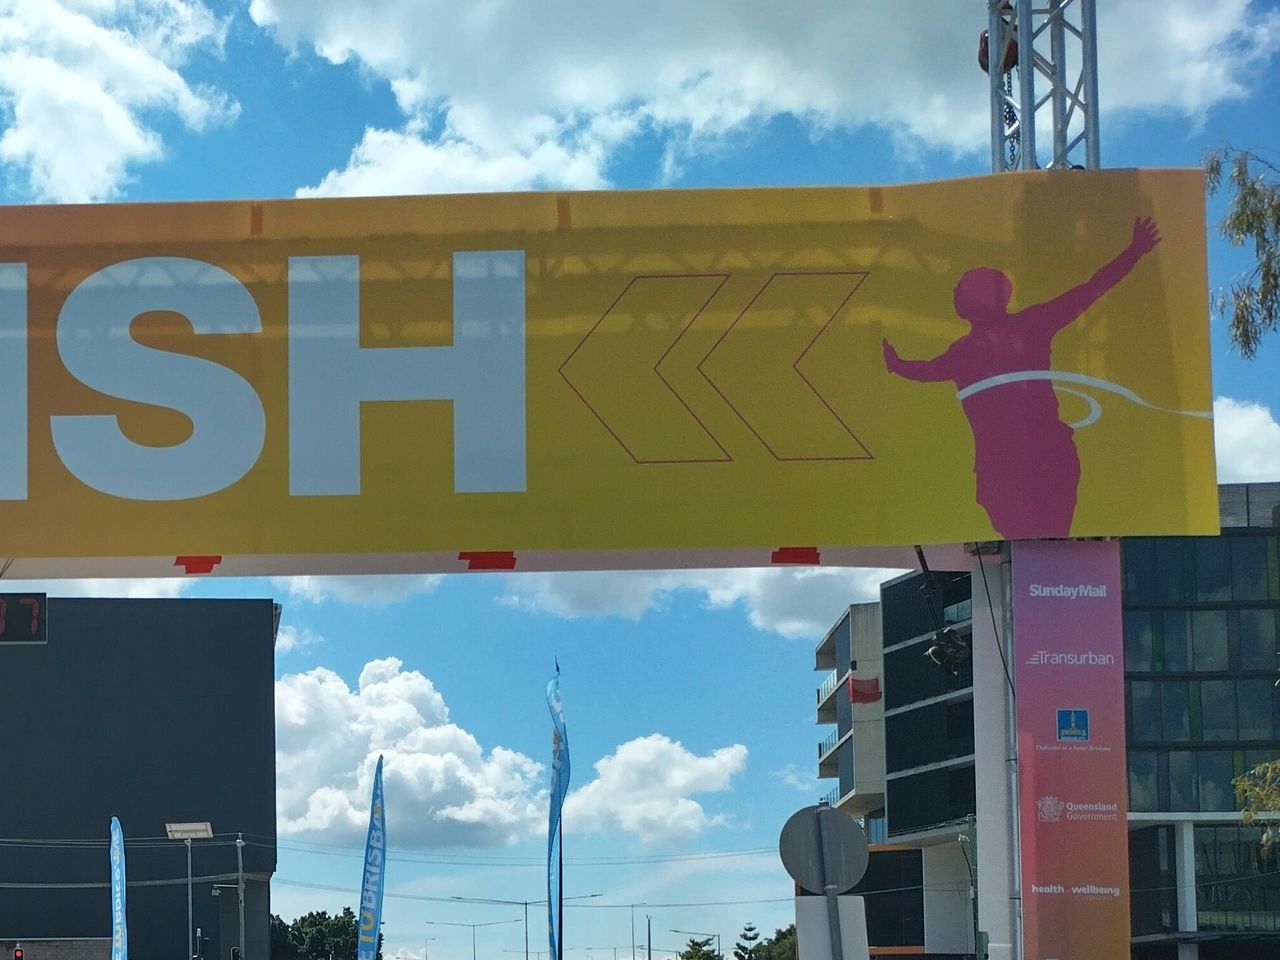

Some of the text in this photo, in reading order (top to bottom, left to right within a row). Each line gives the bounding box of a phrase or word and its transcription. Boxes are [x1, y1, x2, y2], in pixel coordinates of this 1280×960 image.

[1038, 650, 1115, 666] Transurban
[1066, 802, 1117, 812] Queensland
[1032, 884, 1120, 896] health wellbeing
